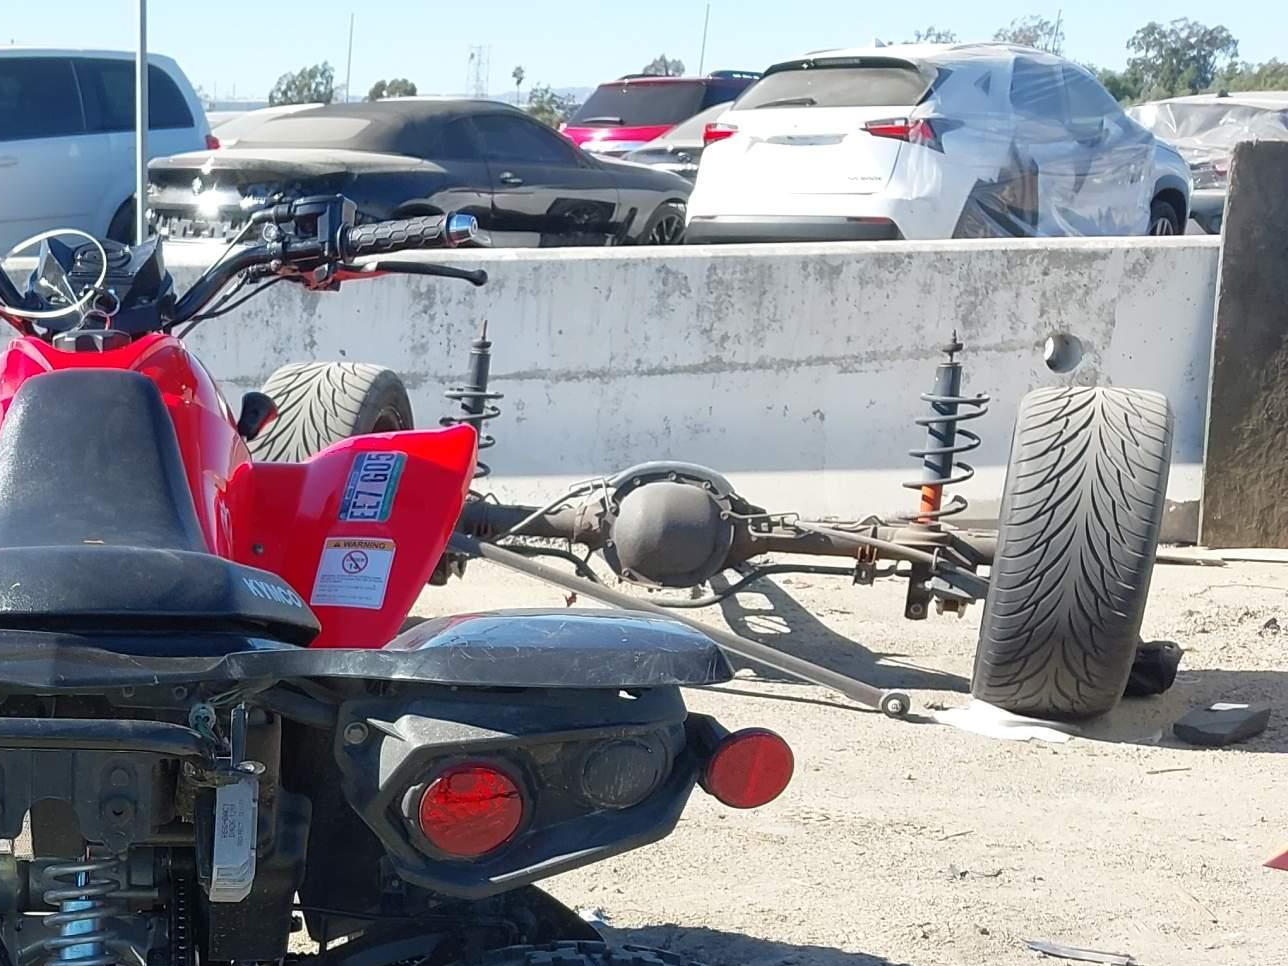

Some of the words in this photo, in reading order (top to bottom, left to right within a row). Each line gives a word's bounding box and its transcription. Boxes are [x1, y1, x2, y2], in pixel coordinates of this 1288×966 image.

[349, 489, 382, 521] EE7
[343, 541, 386, 550] WARNING
[243, 577, 302, 608] KYMCO
